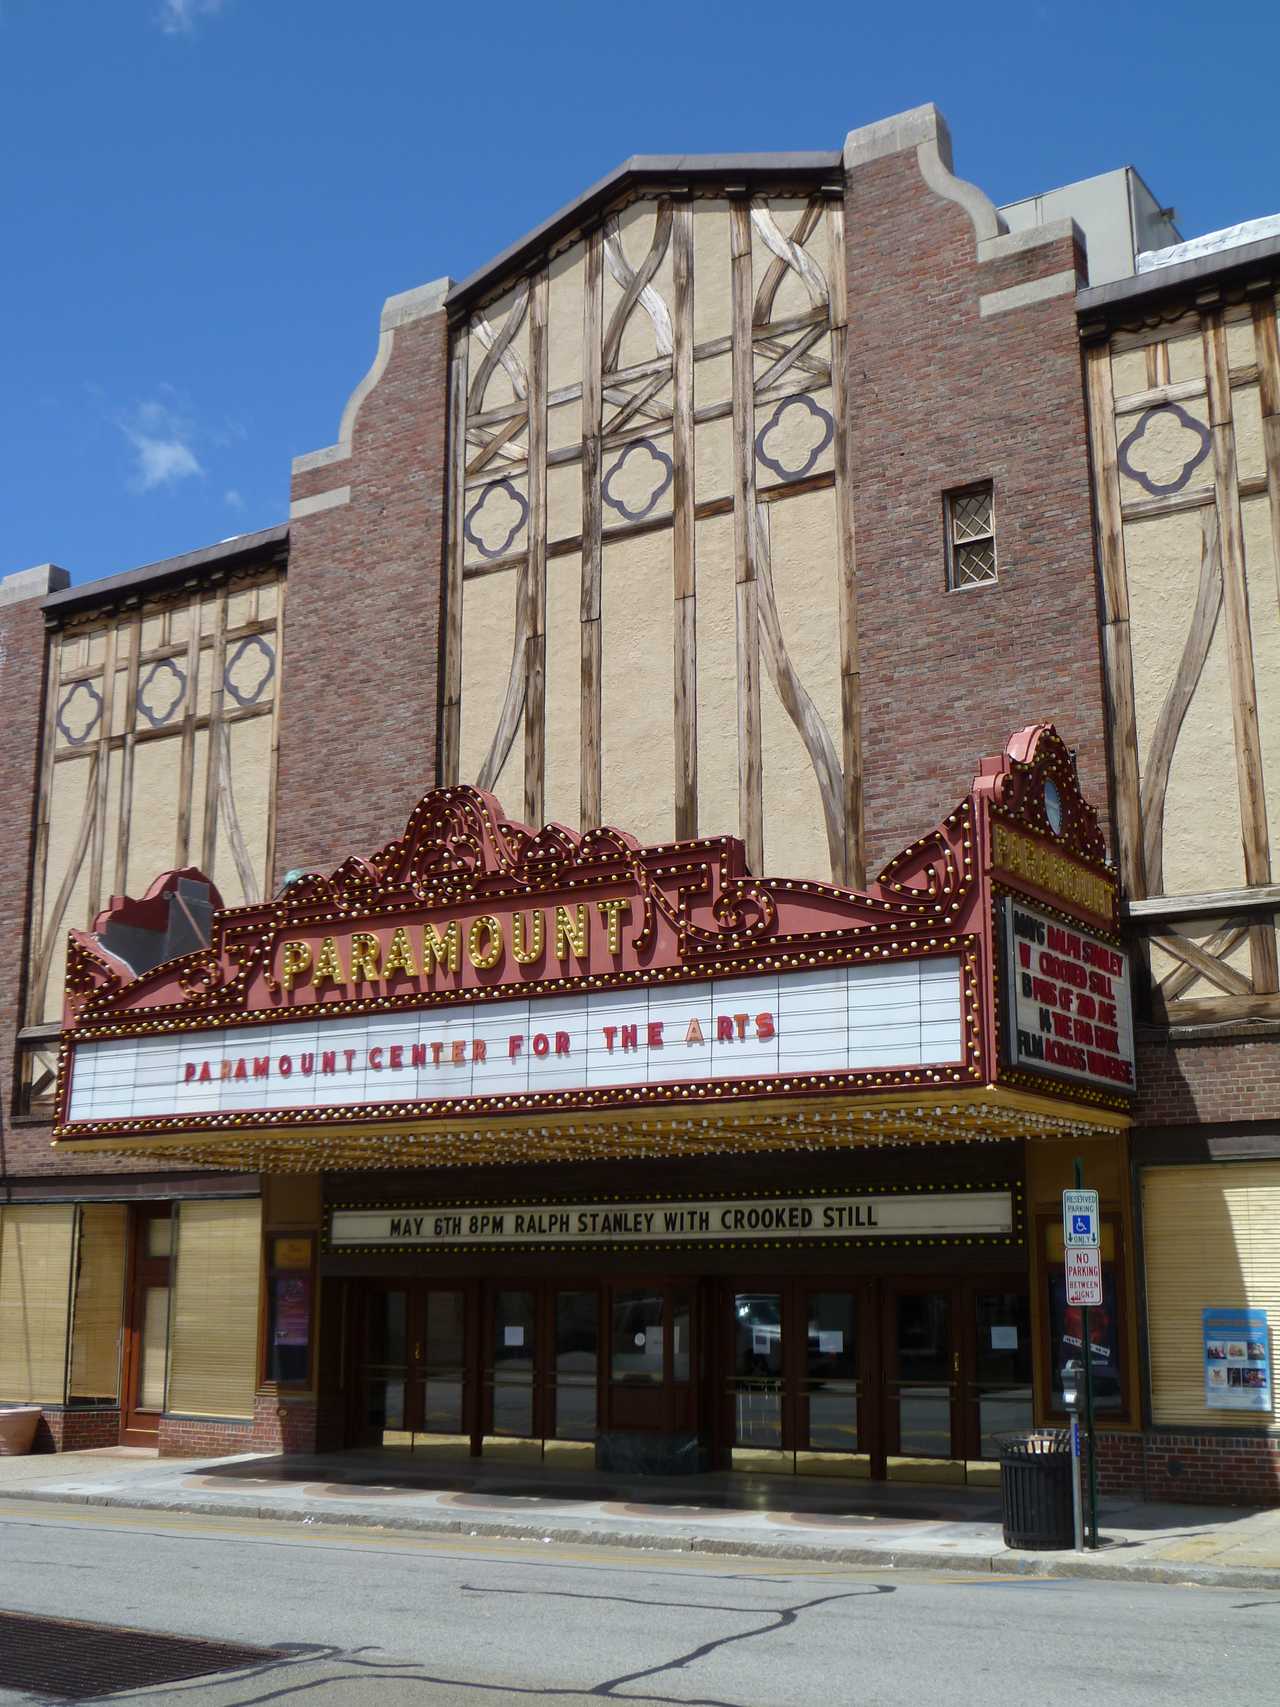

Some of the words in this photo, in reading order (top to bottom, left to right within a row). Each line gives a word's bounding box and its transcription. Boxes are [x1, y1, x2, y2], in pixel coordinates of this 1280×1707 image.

[282, 899, 630, 991] PARAMOUNT
[1047, 925, 1081, 960] RALPH
[1082, 941, 1123, 977] STANLEY
[1039, 951, 1088, 989] CROOKED
[184, 1048, 357, 1083] PARAMOUNT
[368, 1038, 487, 1070] CENTER
[508, 1030, 571, 1059] FOR
[602, 1021, 665, 1051] THE
[685, 1012, 776, 1045] ARTS
[1045, 1037, 1087, 1071] ACROSS
[1066, 1195, 1096, 1203] RESERVED
[1067, 1204, 1094, 1213] PARKING
[389, 1217, 423, 1237] MAY
[434, 1216, 461, 1235] 6TH
[469, 1215, 504, 1234] 8PM
[514, 1214, 570, 1233] RALPH
[577, 1212, 654, 1233] STANLEY
[663, 1210, 710, 1232] WITH
[720, 1207, 813, 1230] CROOKED
[823, 1206, 878, 1228] STILL
[1073, 1235, 1091, 1243] ONLY
[1076, 1253, 1089, 1264] NO
[1068, 1265, 1099, 1277] PARKING
[1069, 1280, 1099, 1289] BETWEEN
[1074, 1290, 1094, 1298] SIGNS
